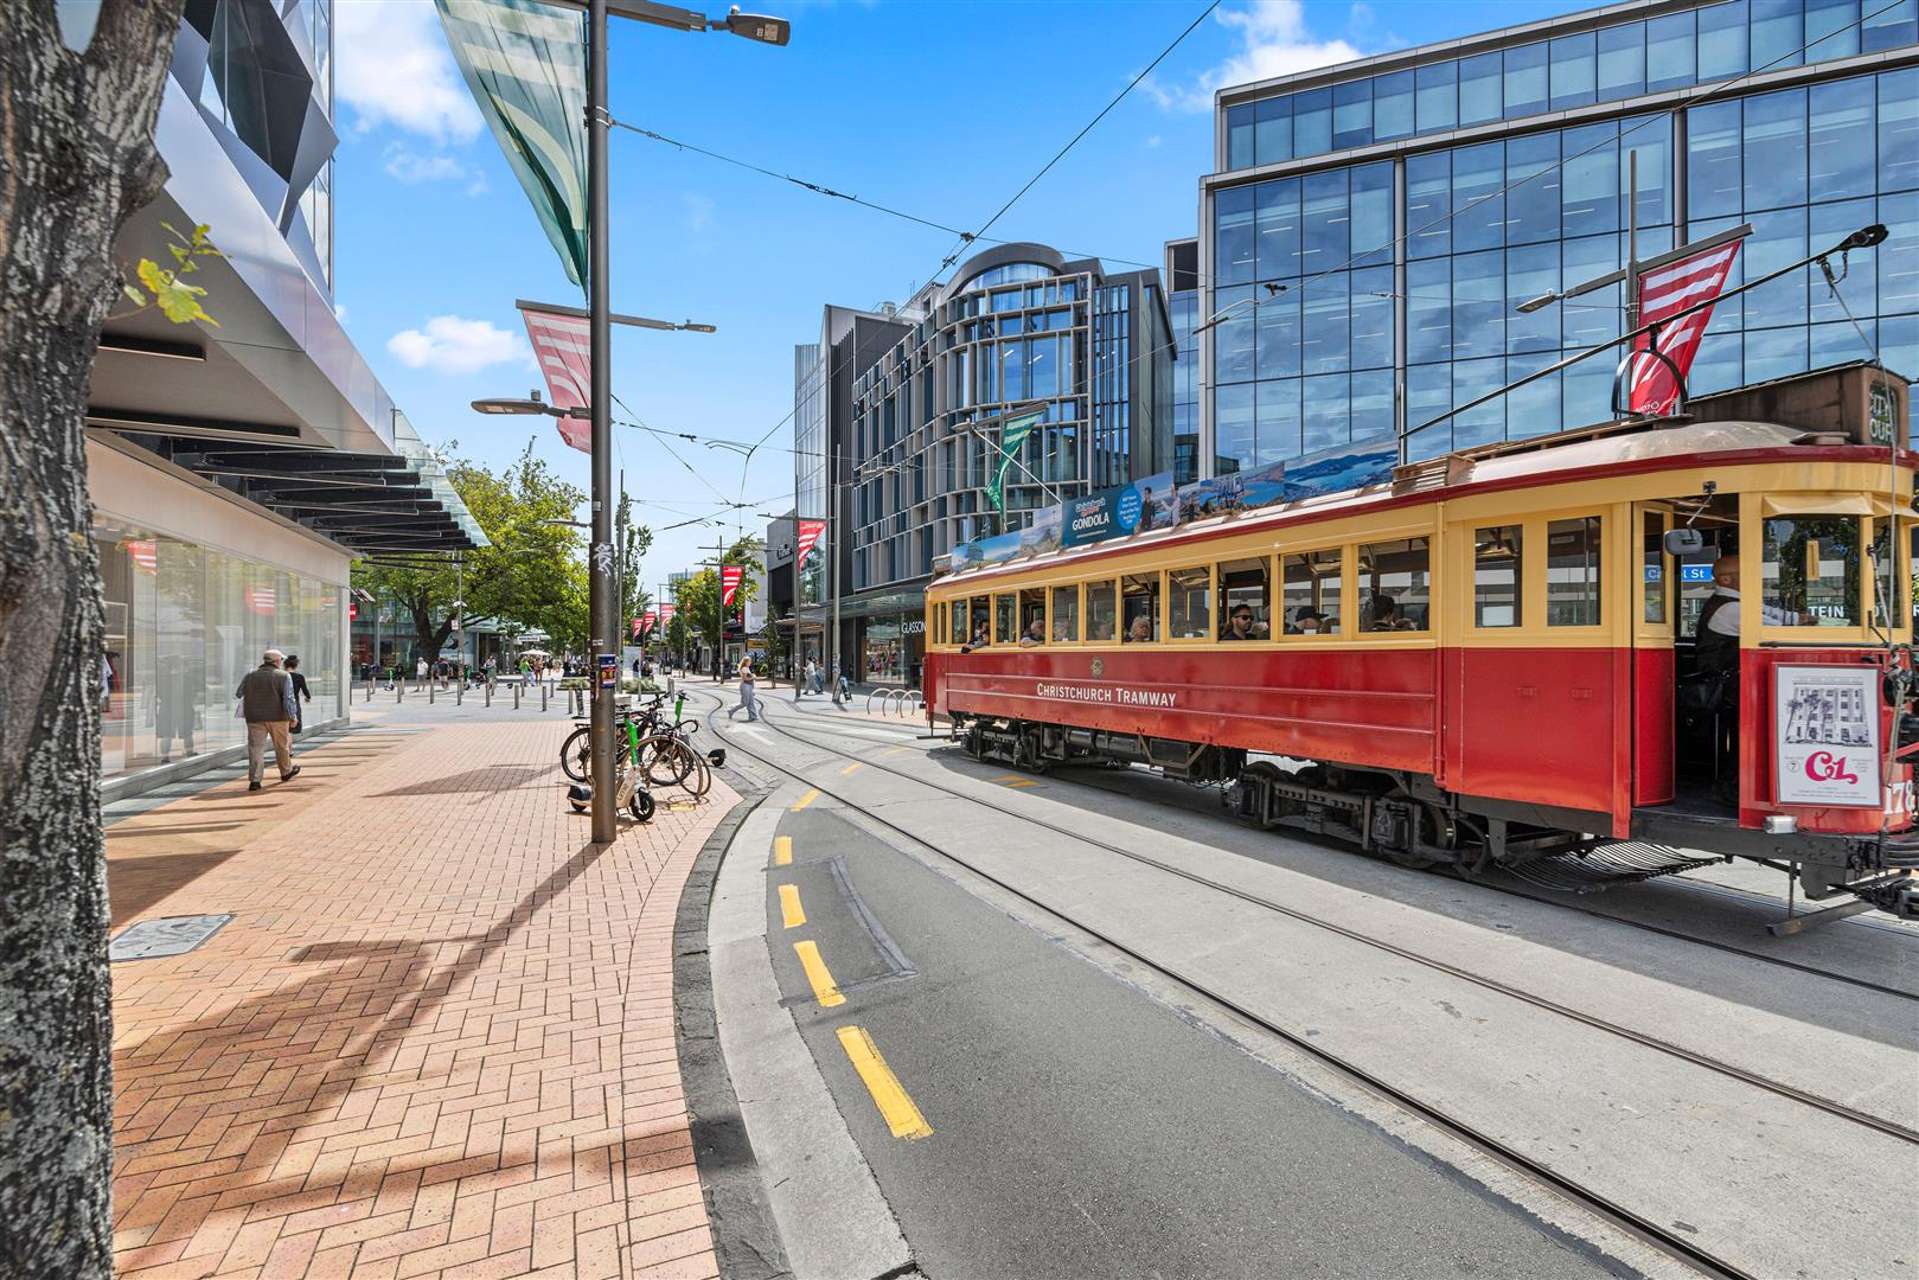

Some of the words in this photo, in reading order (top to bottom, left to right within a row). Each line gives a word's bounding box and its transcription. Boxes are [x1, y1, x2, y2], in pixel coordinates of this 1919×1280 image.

[1870, 419, 1895, 442] OUR
[1072, 512, 1110, 530] GONDOLA
[1691, 568, 1705, 579] St
[1884, 779, 1916, 814] 178
